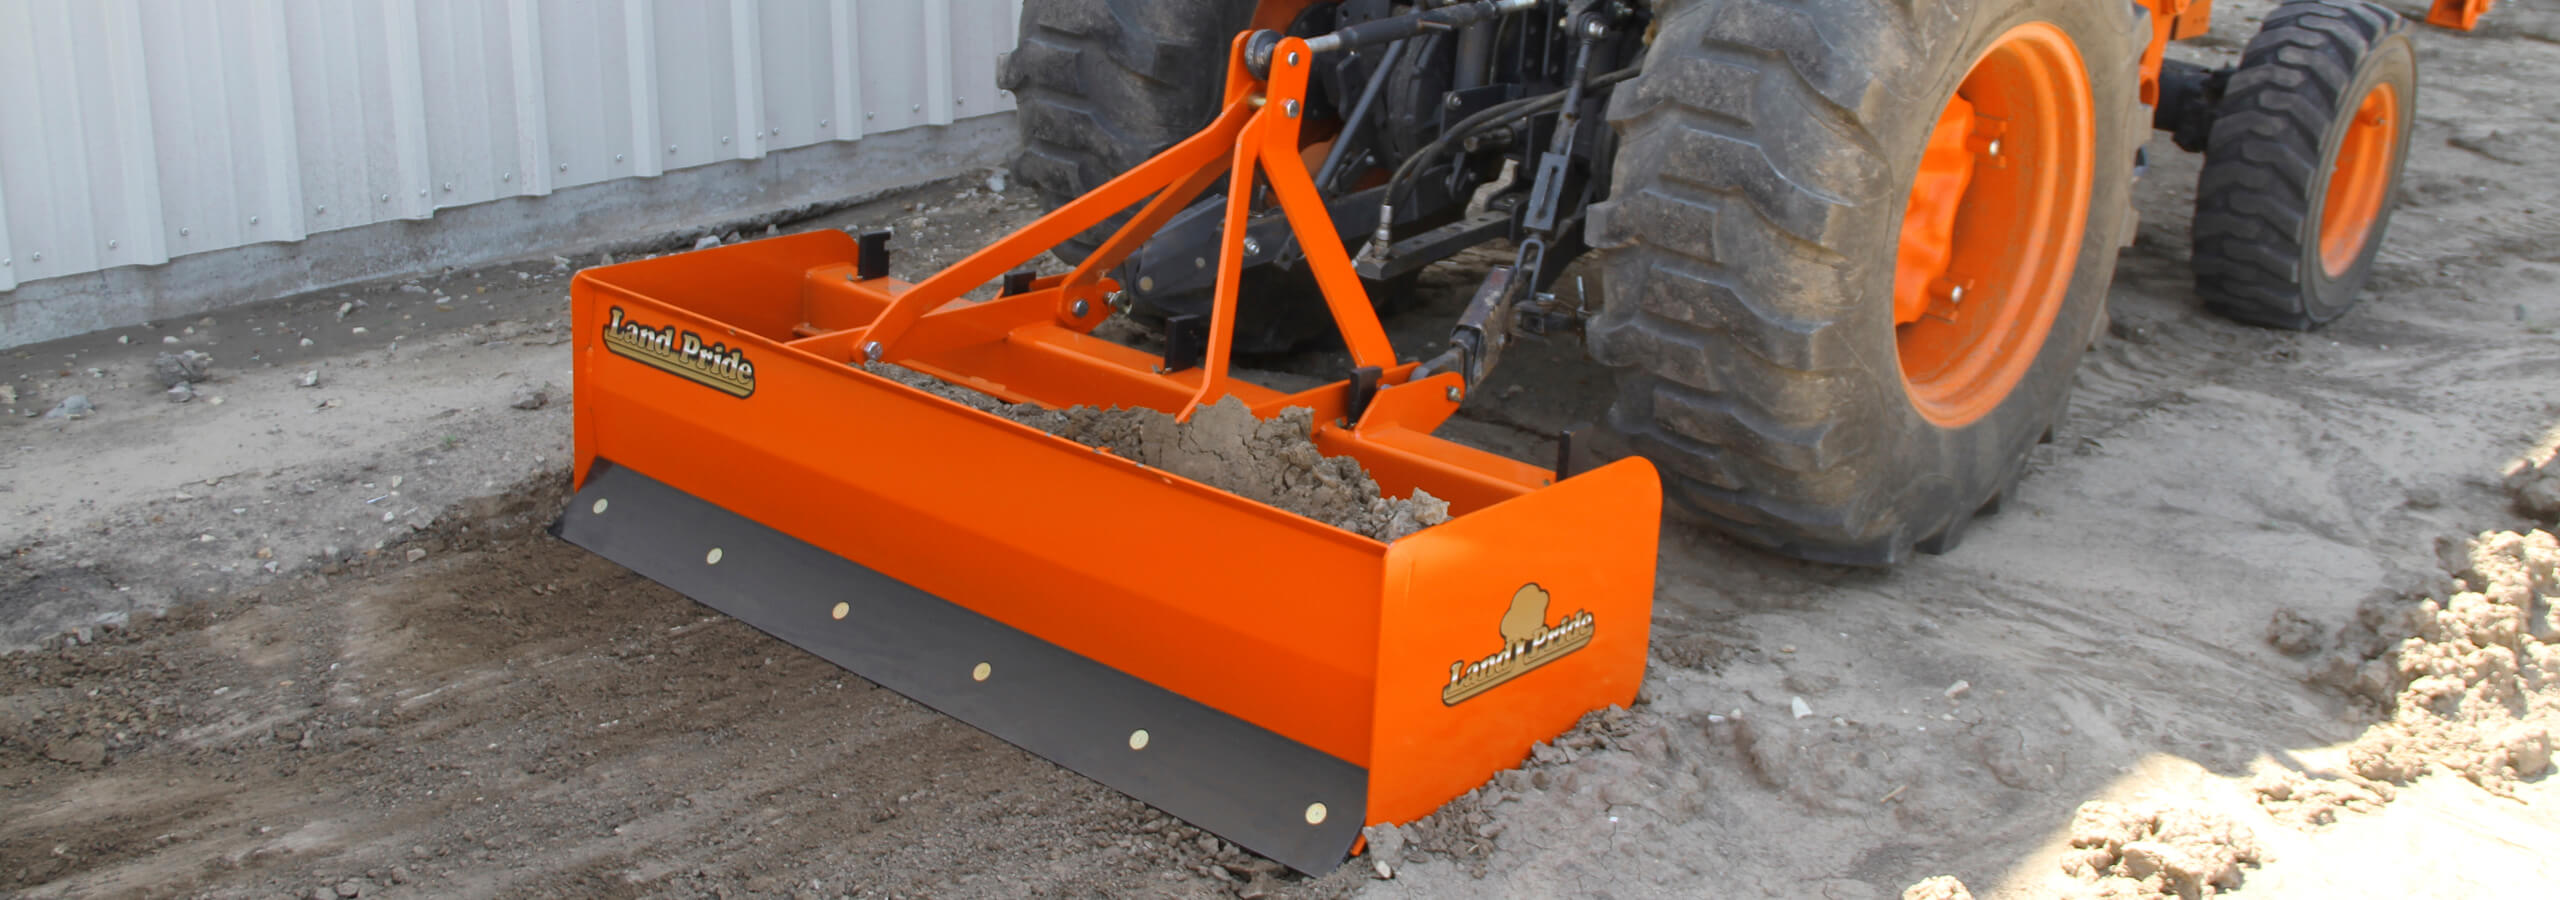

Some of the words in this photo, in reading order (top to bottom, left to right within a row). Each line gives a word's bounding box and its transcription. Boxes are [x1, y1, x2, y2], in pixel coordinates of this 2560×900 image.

[608, 307, 675, 357] Land
[679, 331, 754, 384] Pride
[1446, 640, 1513, 695] Land
[1523, 609, 1594, 659] Pride
